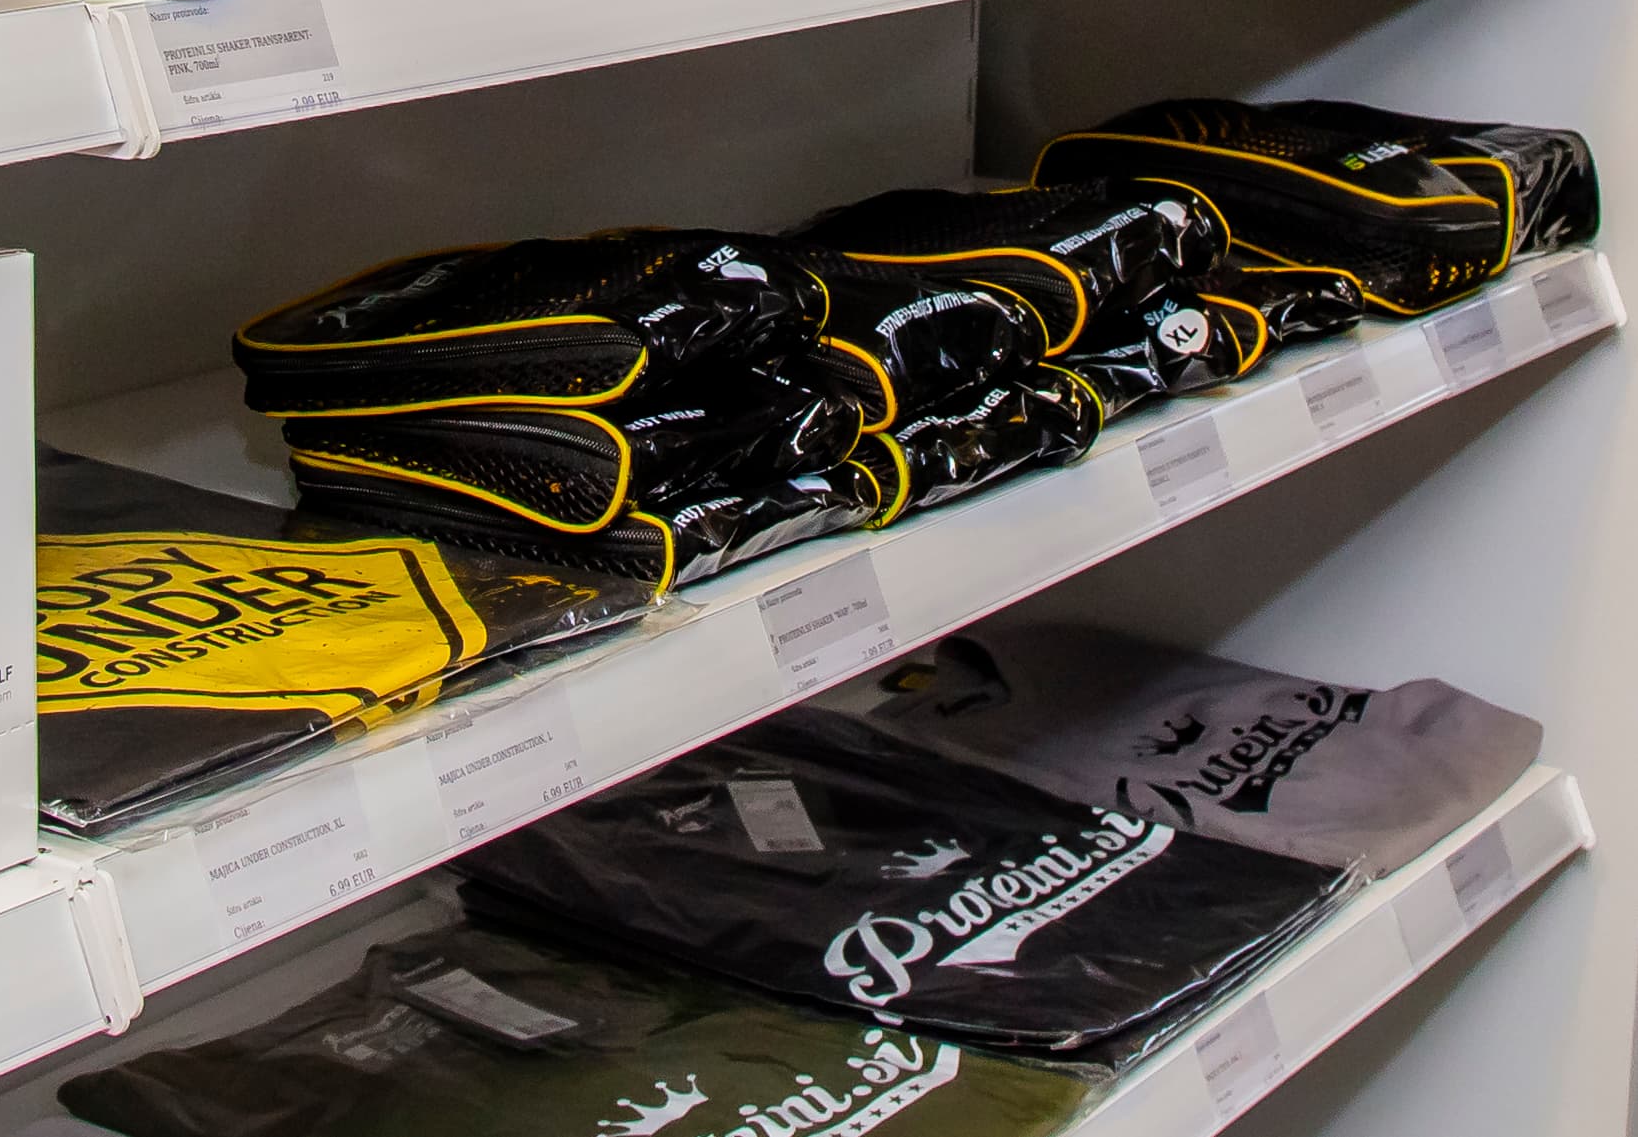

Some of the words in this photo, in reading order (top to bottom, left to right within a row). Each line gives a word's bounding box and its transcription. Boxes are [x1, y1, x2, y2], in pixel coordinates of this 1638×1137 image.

[217, 38, 252, 54] SHAKER
[252, 29, 313, 48] TRANSPARENT-
[194, 59, 220, 73] 700ml
[698, 244, 739, 272] SIZE
[932, 293, 960, 313] WITH
[1143, 298, 1178, 326] SIZE
[1166, 324, 1198, 347] XL
[984, 388, 1010, 407] GEL
[37, 547, 219, 630] ODY
[79, 590, 401, 689] CONSTRUCTION
[438, 767, 466, 787] MAJICA
[465, 756, 493, 775] UNDER
[492, 735, 546, 764] CONSTRUCTION,
[563, 775, 584, 793] EUR
[209, 861, 241, 881] MAJICA
[240, 848, 270, 868] UNDER
[270, 821, 333, 856] CONSTRUCTION,
[333, 816, 346, 830] XL
[233, 919, 267, 940] Cijena:
[353, 867, 376, 887] EUR
[823, 805, 1146, 1006] Proteini.si
